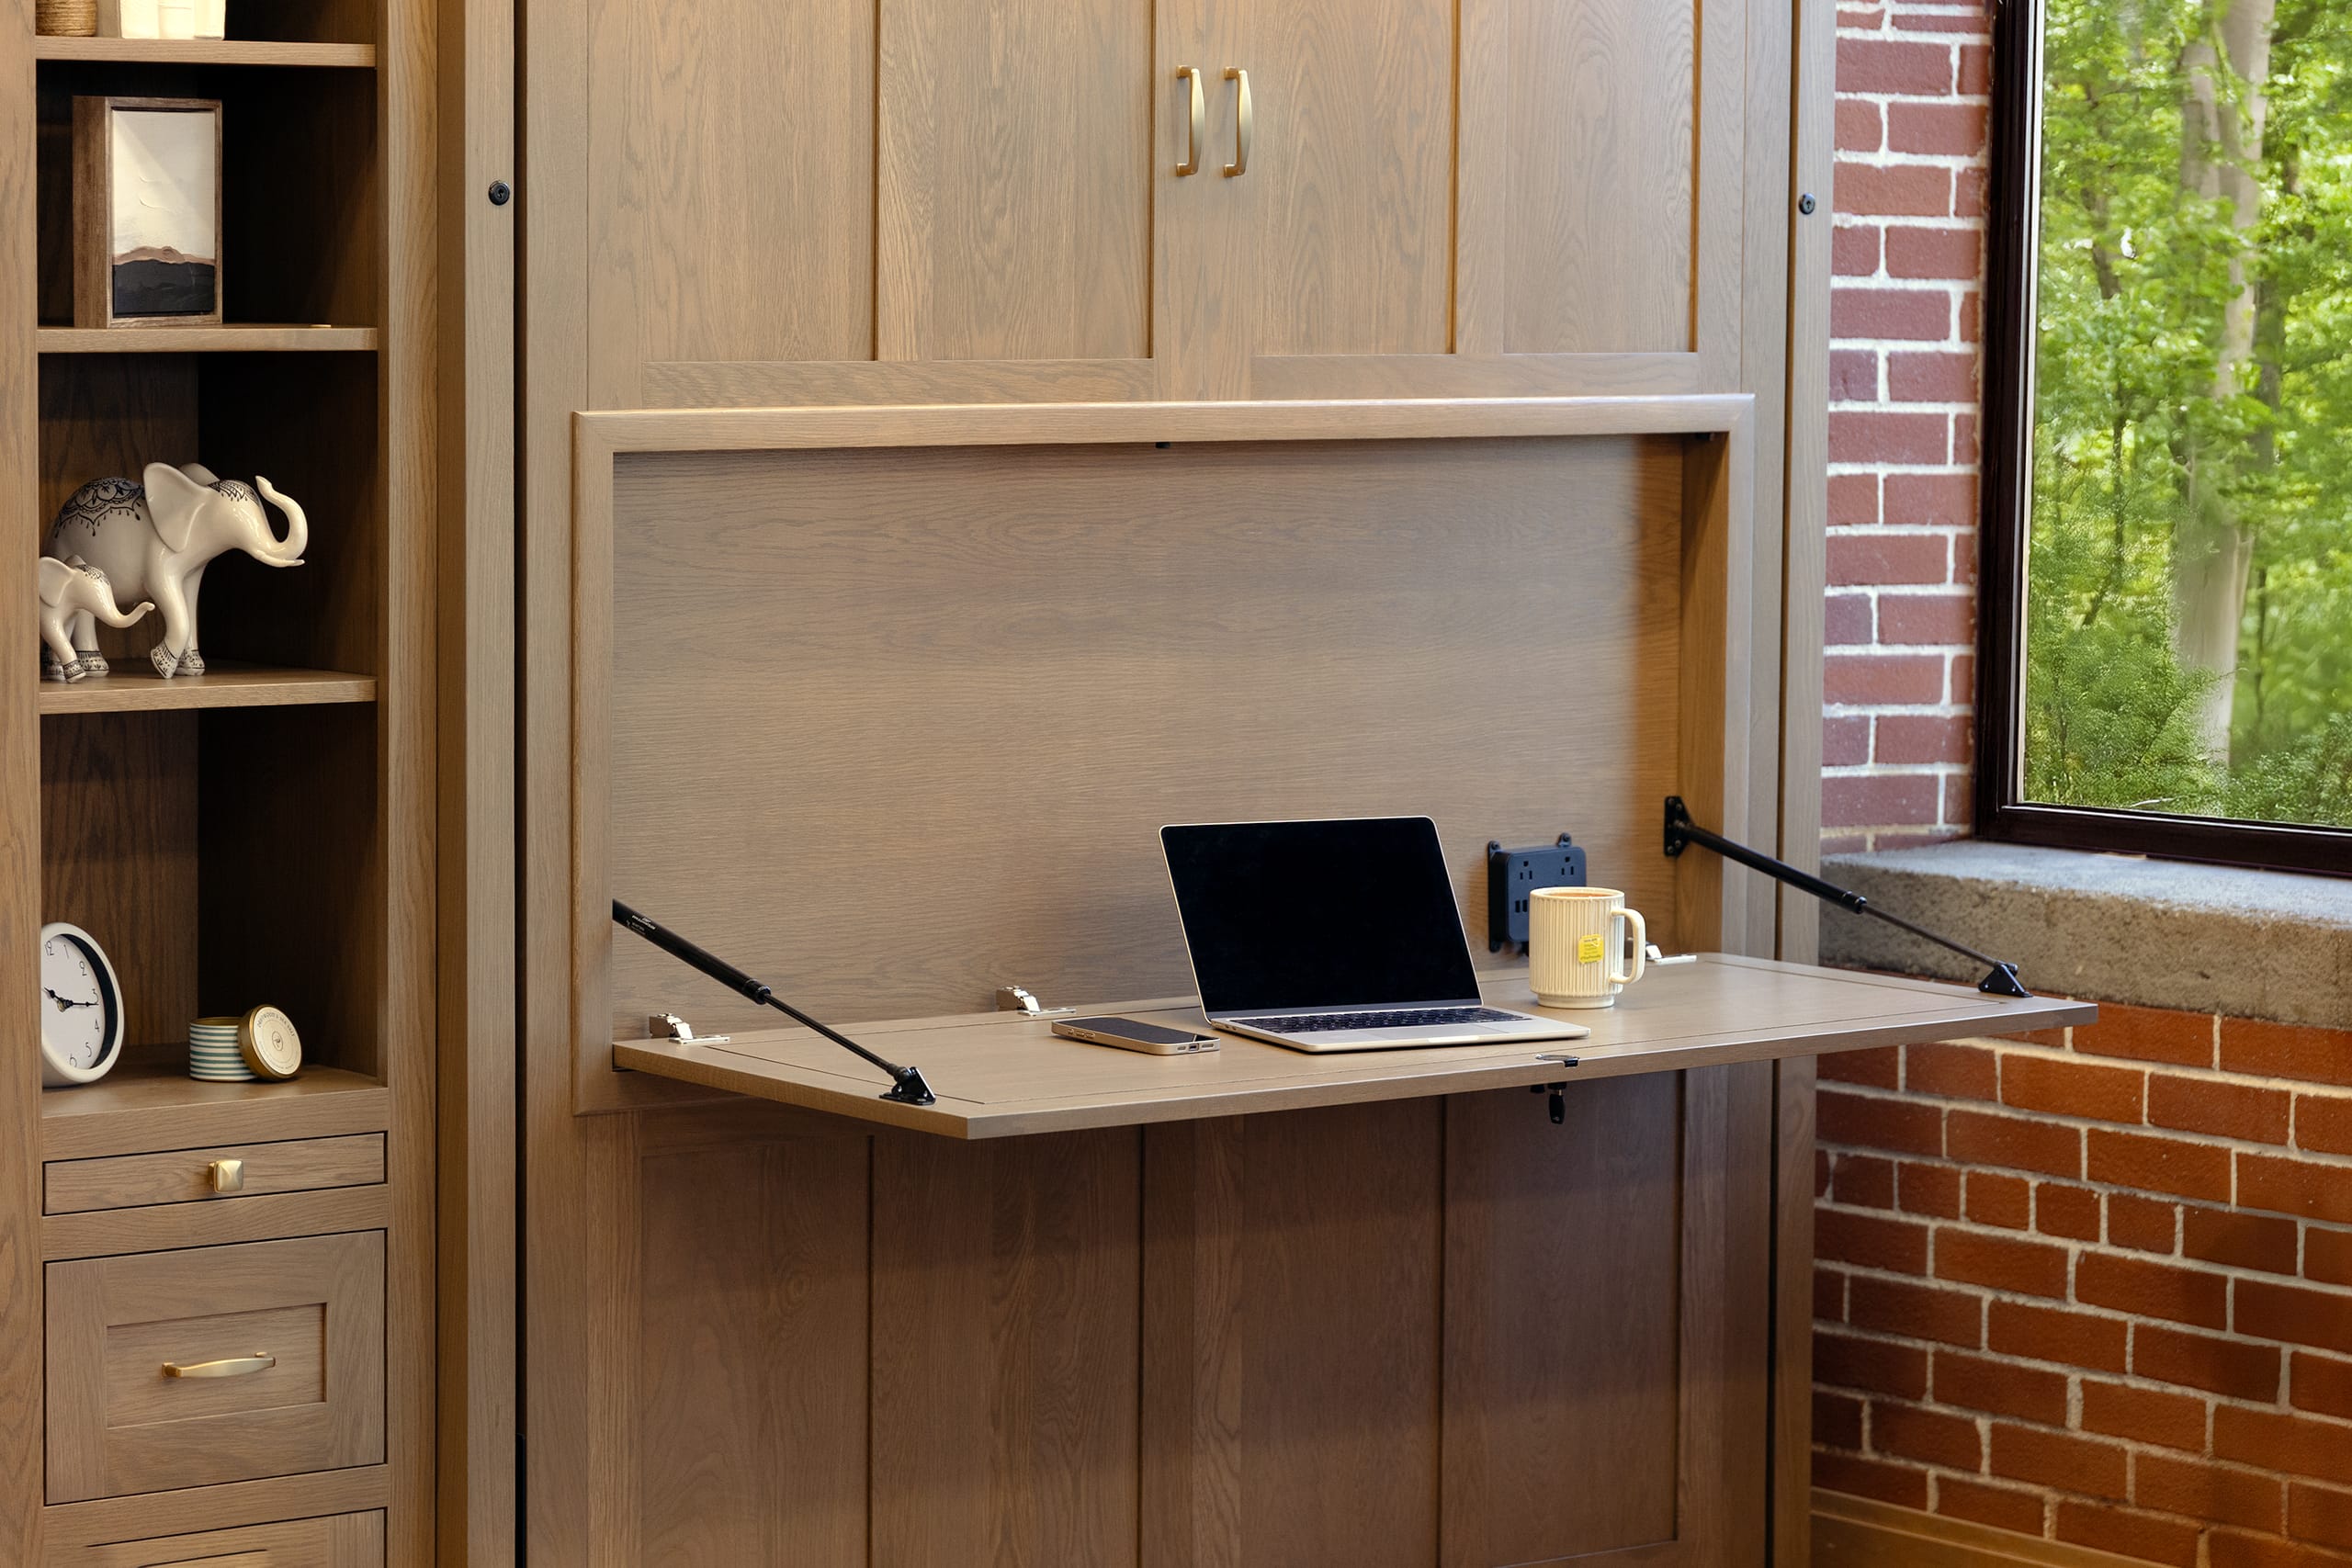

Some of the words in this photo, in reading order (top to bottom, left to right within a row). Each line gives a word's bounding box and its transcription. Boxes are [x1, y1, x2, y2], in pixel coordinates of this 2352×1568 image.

[44, 940, 54, 956] 12
[63, 943, 69, 960] 1
[79, 961, 87, 976] 2
[92, 987, 99, 1005] 3
[95, 1018, 100, 1032] 4
[85, 1042, 92, 1058] 5
